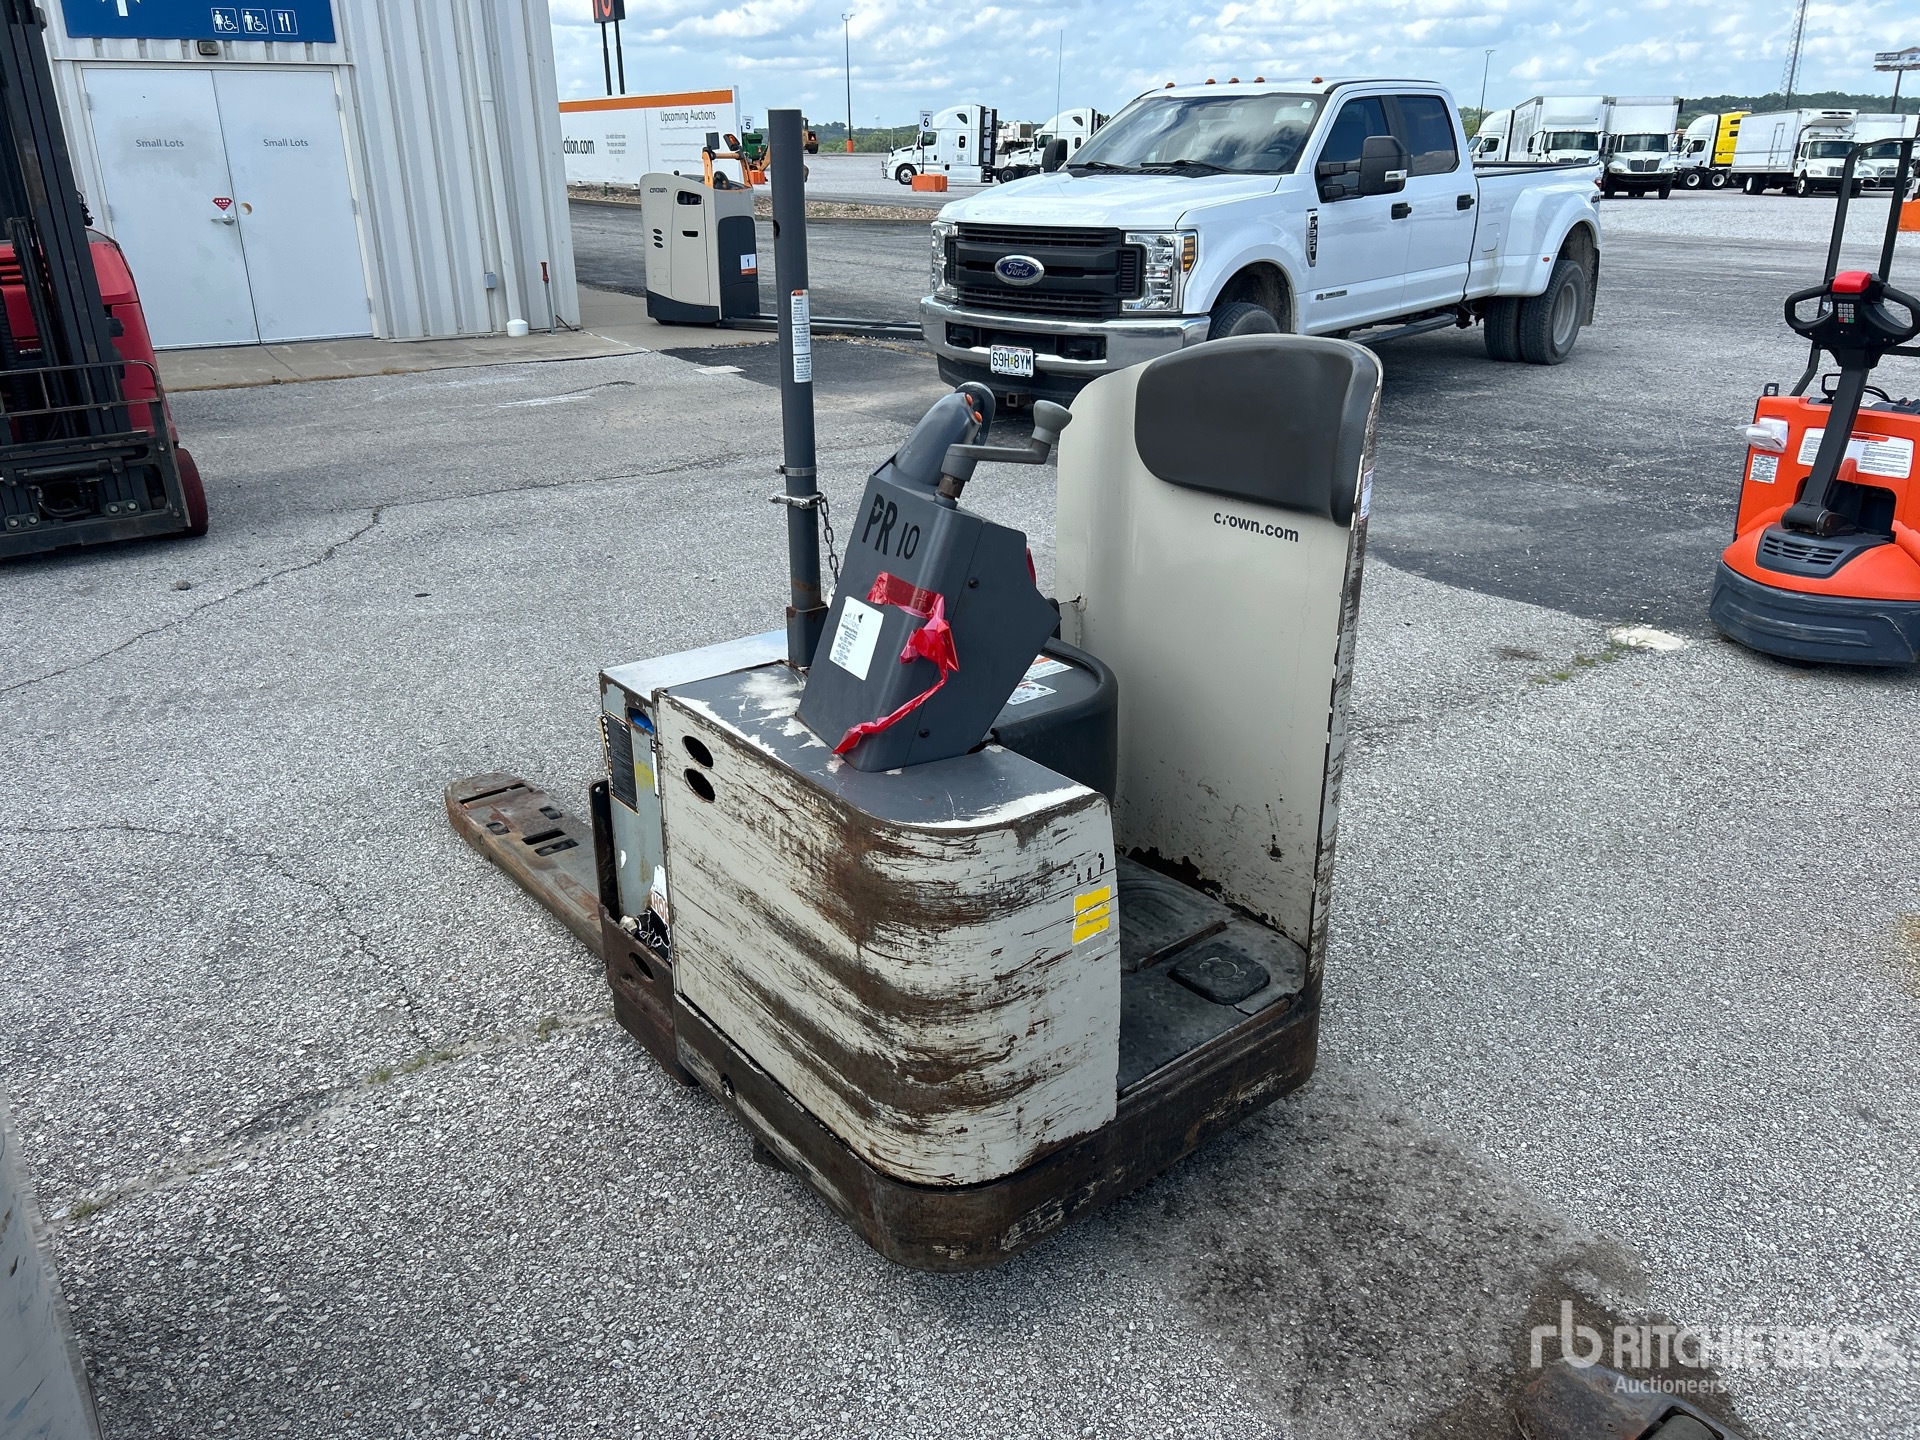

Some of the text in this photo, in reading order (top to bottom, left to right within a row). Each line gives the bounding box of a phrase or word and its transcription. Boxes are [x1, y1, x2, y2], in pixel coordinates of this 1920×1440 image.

[660, 108, 716, 124] Upcoming Auctions
[923, 117, 930, 128] 6
[745, 121, 751, 130] 5
[135, 138, 185, 148] Small Lots
[263, 138, 309, 147] Small Lots
[1006, 262, 1030, 277] Ford
[992, 351, 1032, 370] 69H 8YM
[862, 493, 921, 560] PR 10
